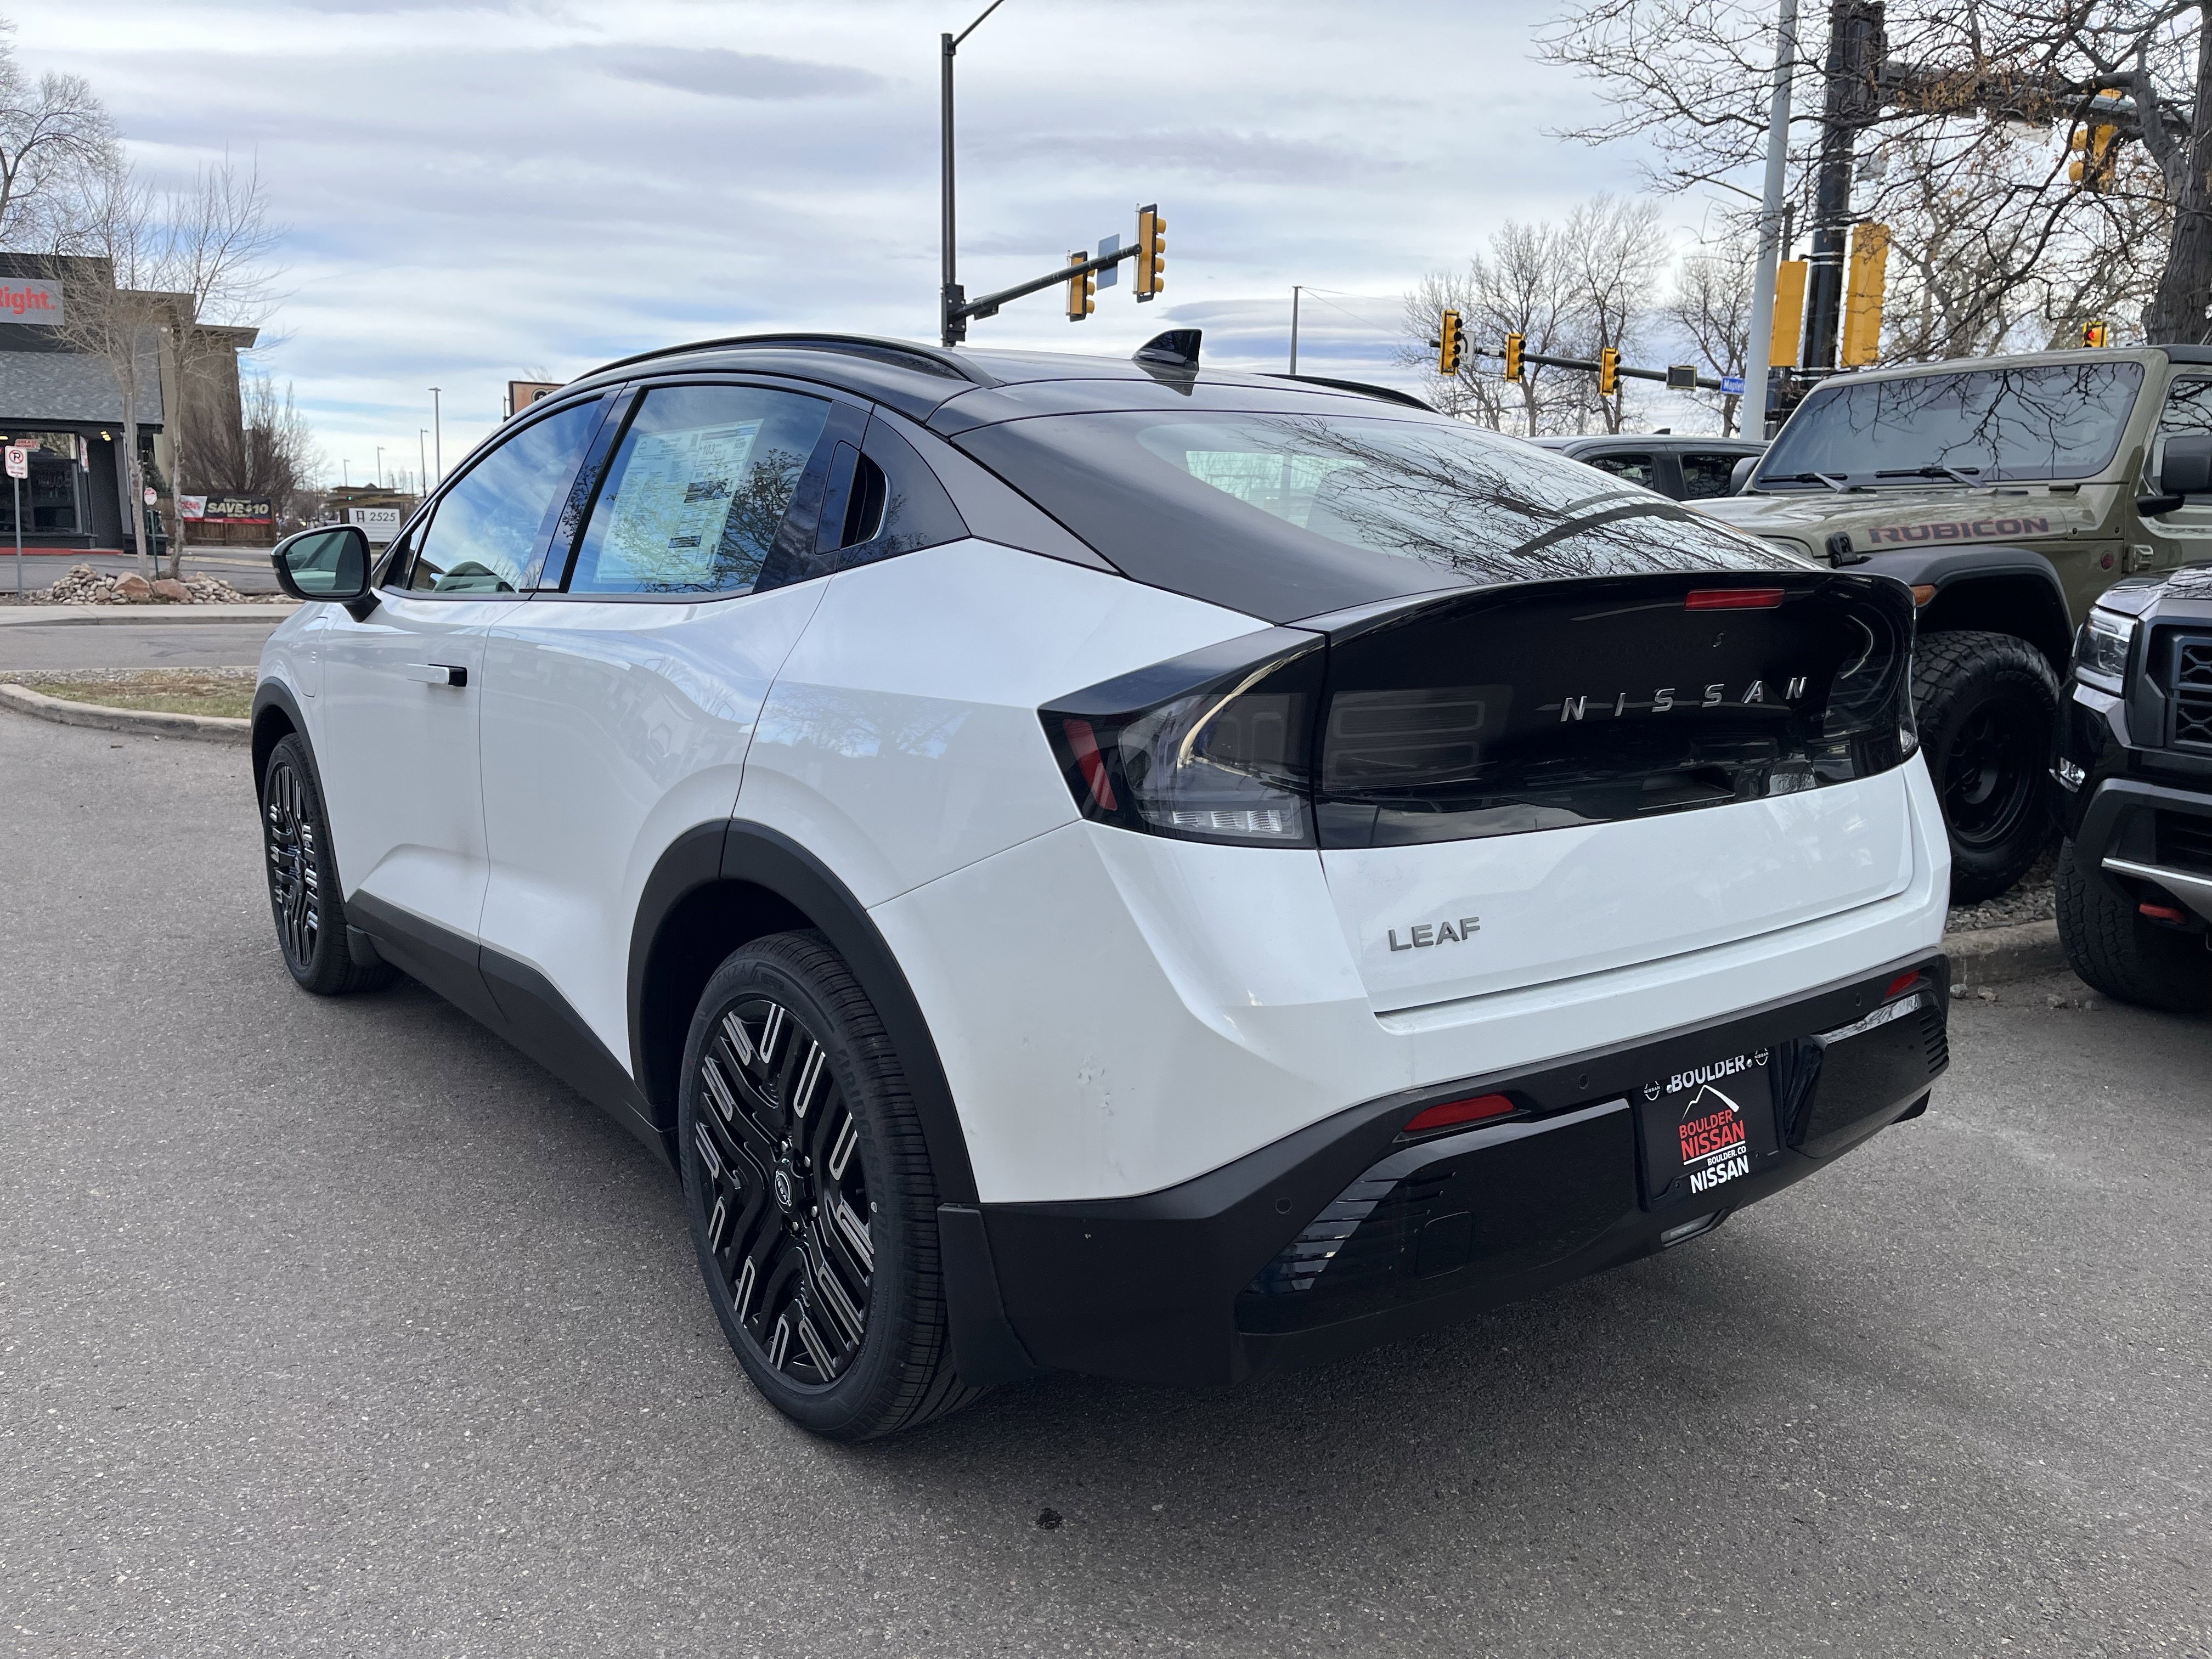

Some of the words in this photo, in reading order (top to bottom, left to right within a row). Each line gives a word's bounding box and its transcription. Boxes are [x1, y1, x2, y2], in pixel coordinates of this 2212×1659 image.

[0, 286, 56, 314] ight.
[207, 502, 244, 514] SAVE
[370, 512, 396, 522] 2525
[1869, 517, 2049, 544] RUBICON
[1560, 676, 1807, 723] NISSAN
[1388, 916, 1481, 952] LEAF
[1671, 1054, 1746, 1092] BOULDER
[1644, 1085, 1661, 1094] NISSAN
[1679, 1109, 1734, 1139] BOULDER
[1681, 1119, 1746, 1161] NISSAN
[1737, 1146, 1747, 1155] CO
[1690, 1155, 1750, 1194] NISSAN
